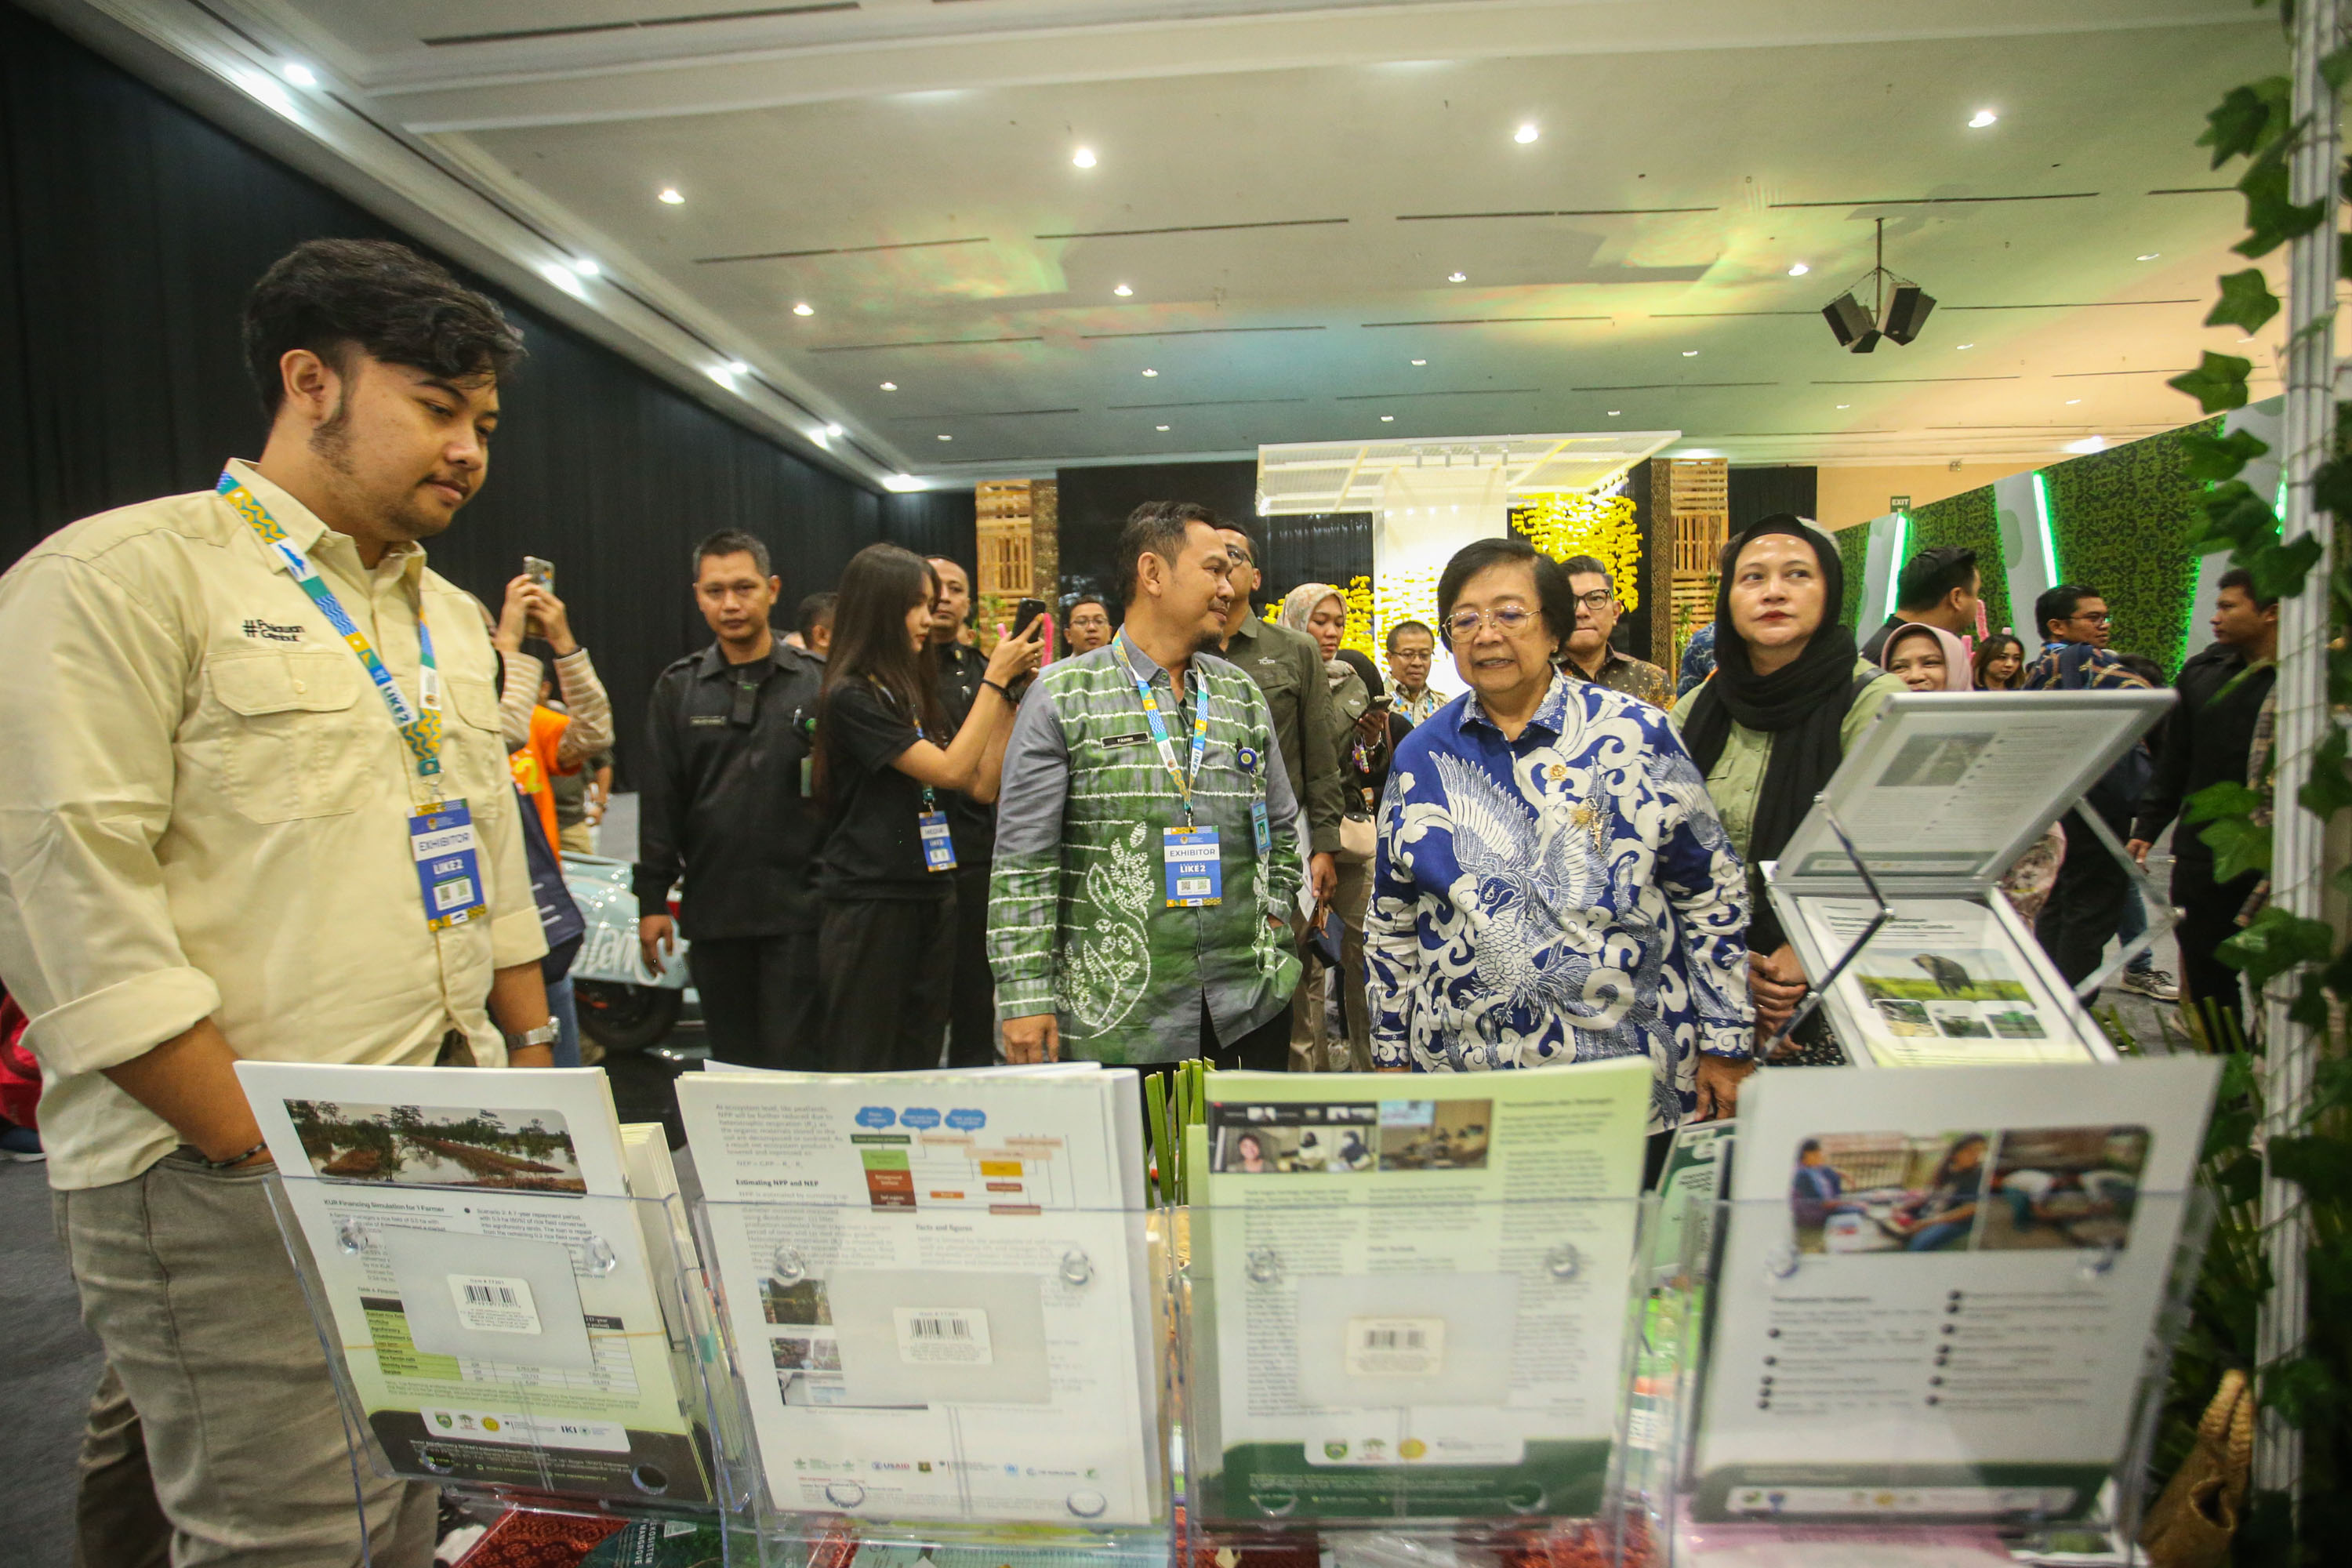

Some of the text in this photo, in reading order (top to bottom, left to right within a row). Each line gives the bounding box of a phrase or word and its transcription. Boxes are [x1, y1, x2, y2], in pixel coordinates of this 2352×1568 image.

[419, 832, 470, 851] EXHIBITOR
[1170, 848, 1215, 857] EXHIBITOR
[735, 1178, 771, 1187] Estimating
[339, 1200, 370, 1209] Financing
[371, 1202, 405, 1210] Simulation
[949, 1224, 972, 1232] figures
[561, 1425, 577, 1434] IKI
[634, 1524, 647, 1565] MANGROVE
[645, 1523, 657, 1564] EKOSISTEM
